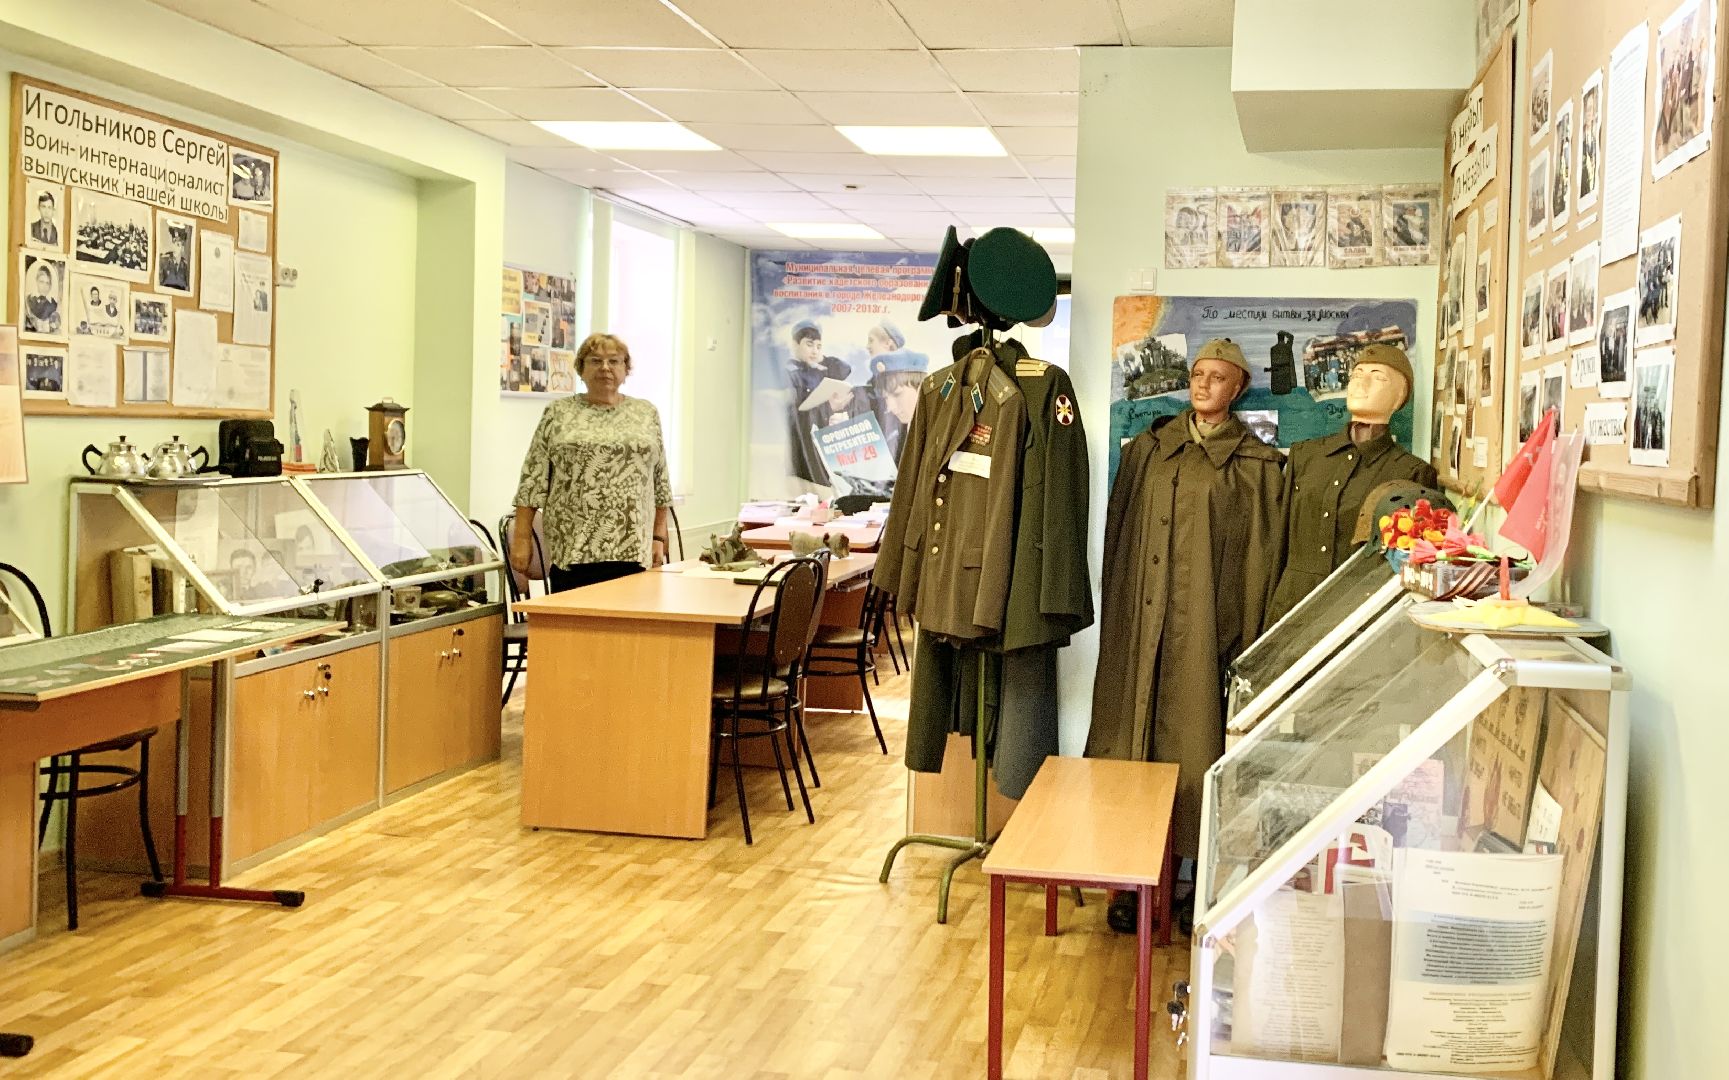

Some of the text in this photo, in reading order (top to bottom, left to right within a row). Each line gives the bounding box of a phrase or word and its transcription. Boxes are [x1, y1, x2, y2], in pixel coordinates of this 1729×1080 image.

[25, 89, 225, 168] Игольников Сергей
[24, 155, 228, 221] выпускник нашей школы
